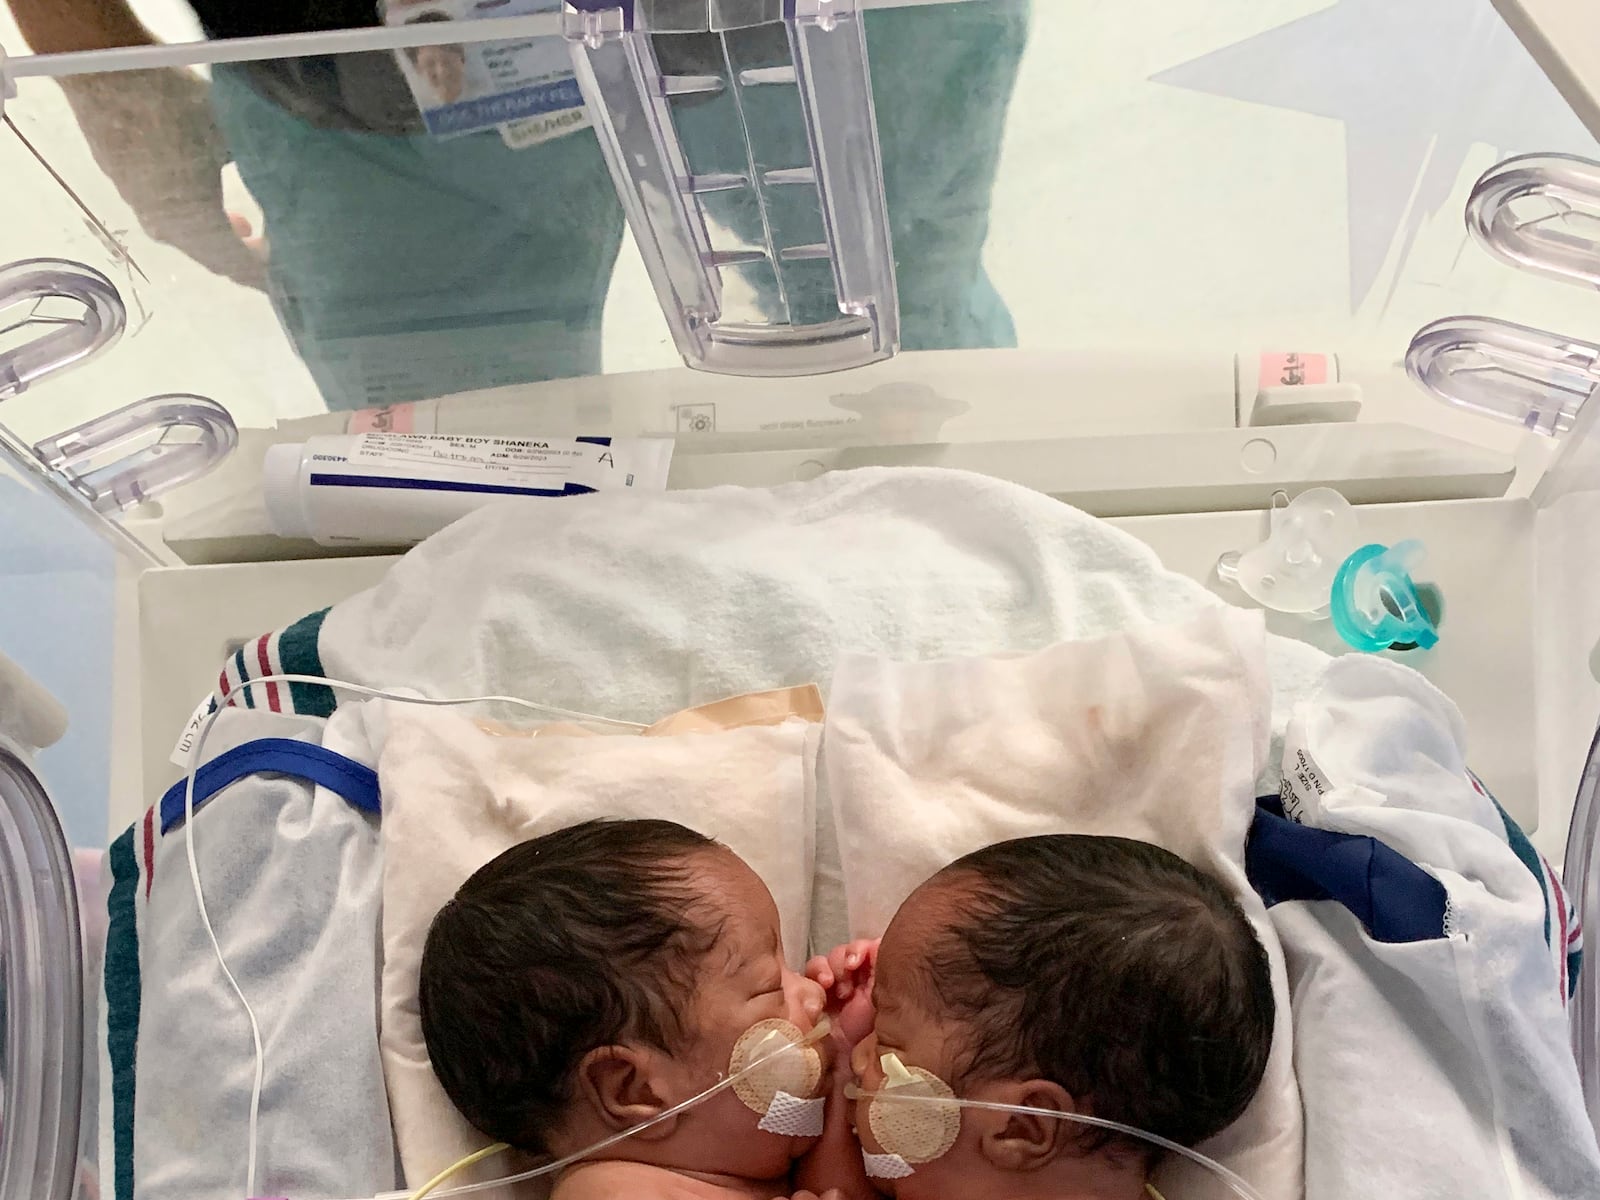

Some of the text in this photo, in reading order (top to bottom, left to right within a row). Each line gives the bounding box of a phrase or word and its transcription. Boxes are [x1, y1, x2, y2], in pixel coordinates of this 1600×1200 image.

[493, 439, 549, 448] SHANEKA
[598, 452, 614, 469] A
[1298, 773, 1312, 791] SIZE
